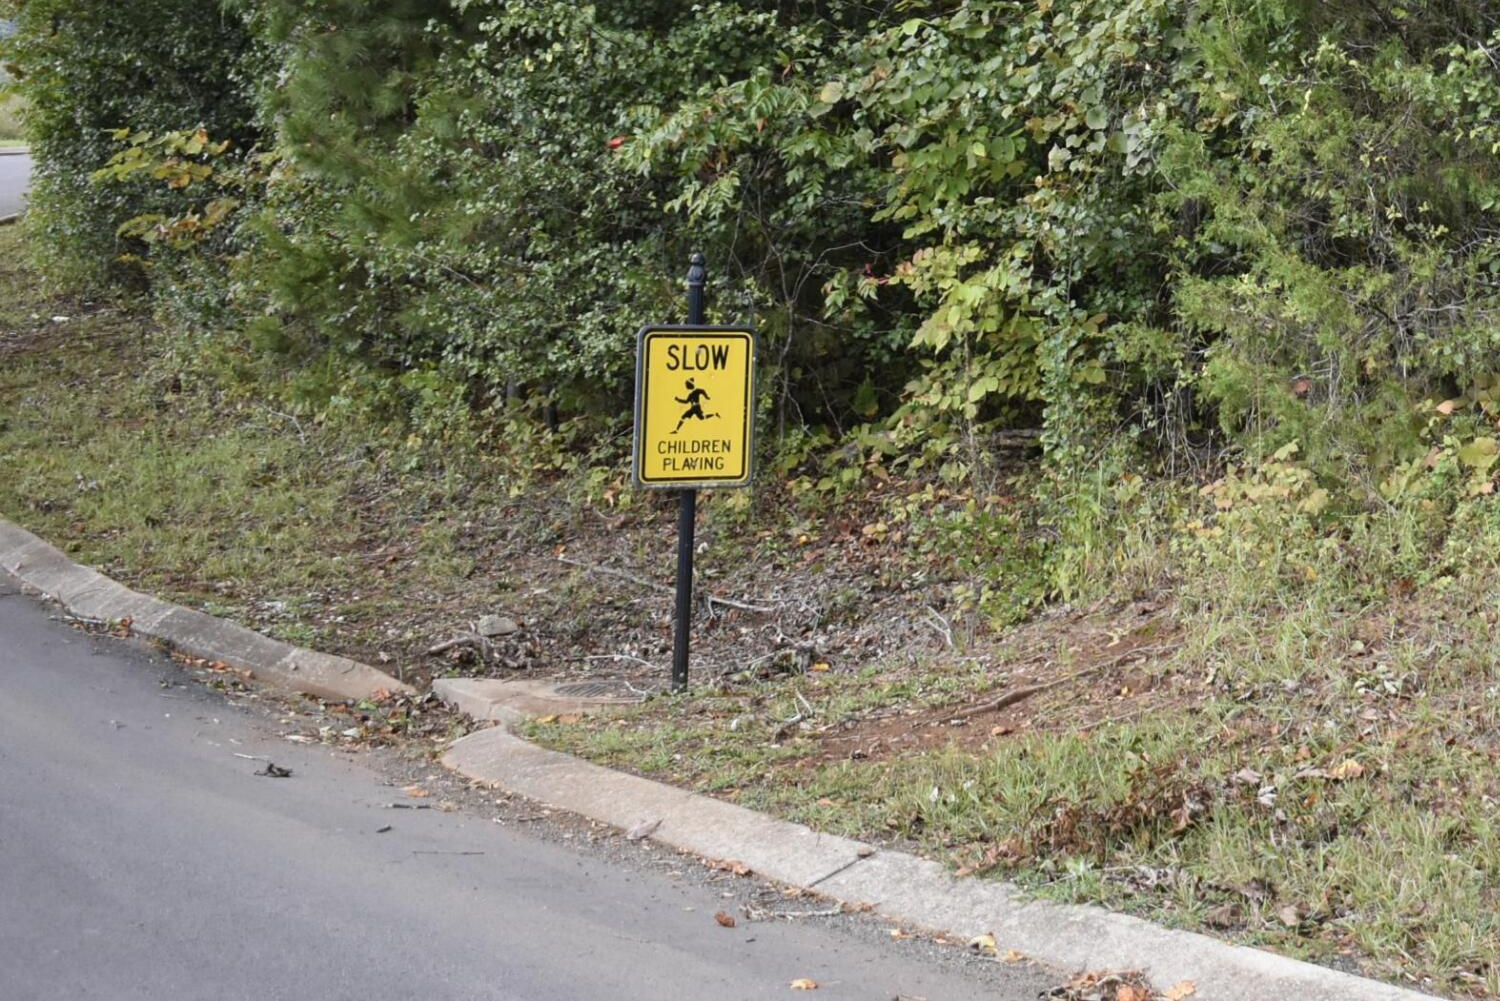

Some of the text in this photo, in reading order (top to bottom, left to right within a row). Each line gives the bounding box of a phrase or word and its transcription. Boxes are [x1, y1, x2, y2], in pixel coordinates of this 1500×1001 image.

[666, 344, 729, 370] SLOW
[657, 439, 731, 454] CHILDREN
[663, 456, 724, 471] PLAYING
